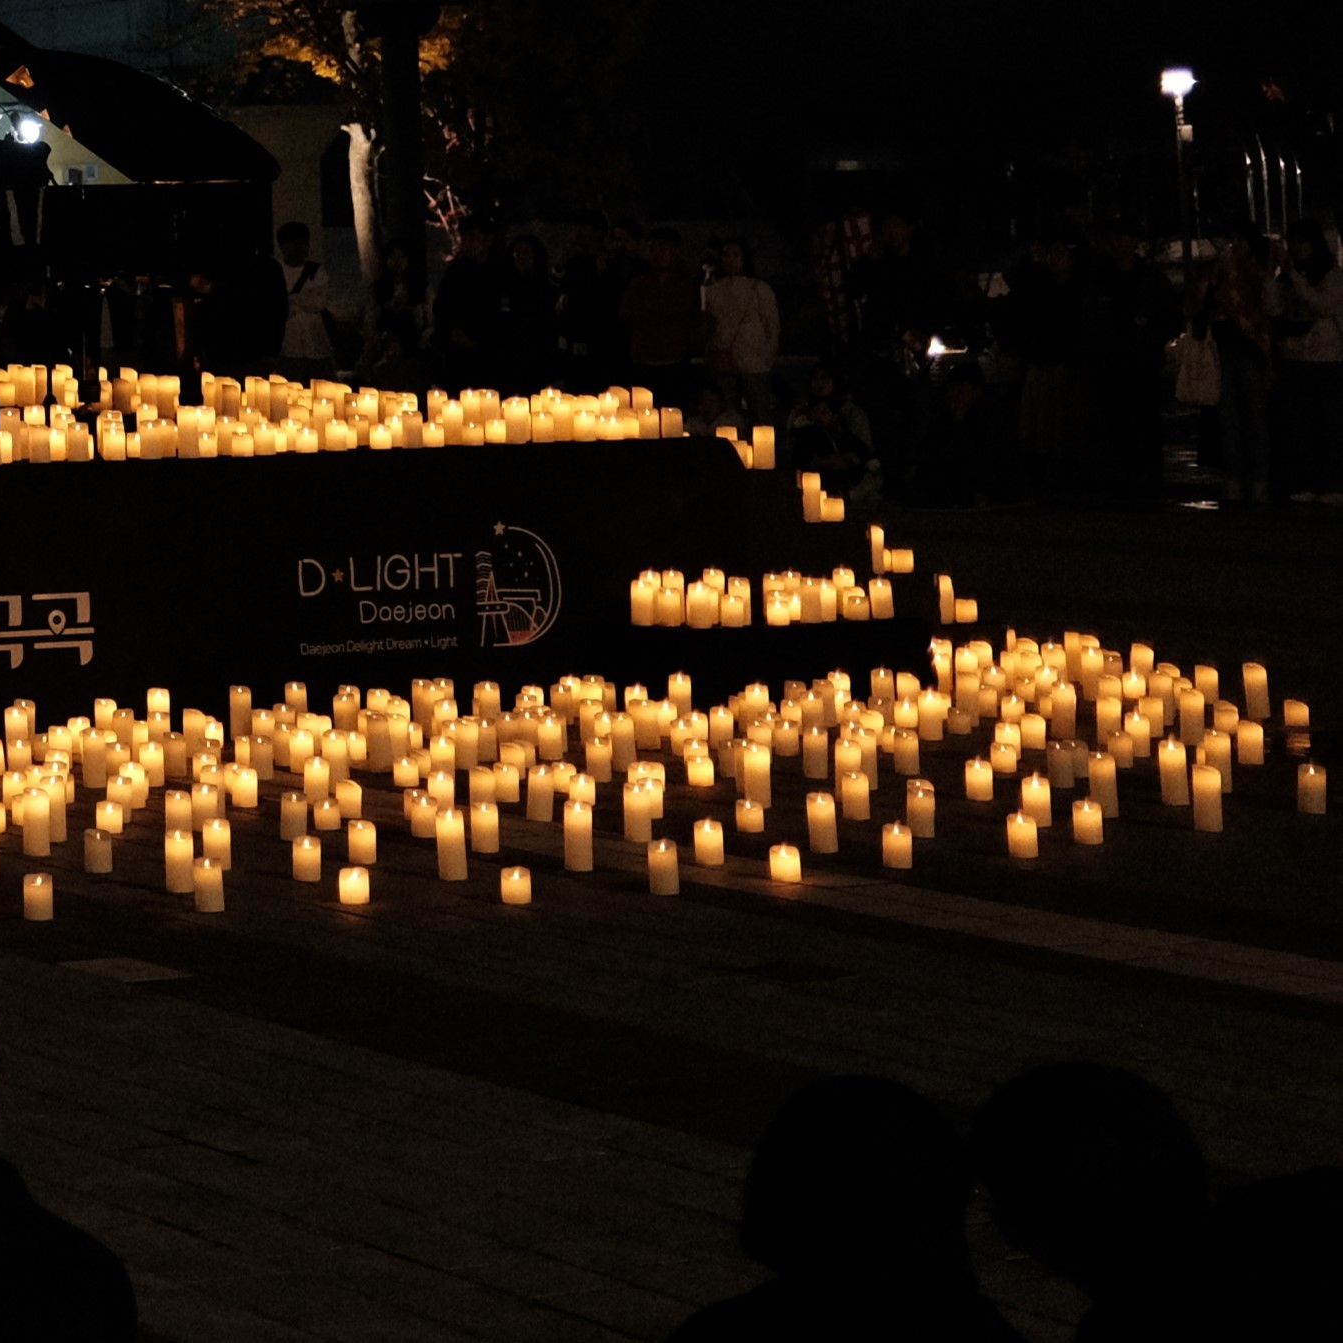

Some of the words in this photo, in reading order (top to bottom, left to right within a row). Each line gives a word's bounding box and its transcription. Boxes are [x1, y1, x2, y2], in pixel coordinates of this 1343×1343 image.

[359, 600, 456, 625] Daejeon
[299, 642, 345, 657] Daejeon
[346, 639, 384, 654] Delight
[385, 638, 423, 651] Dream
[430, 635, 459, 650] Light
